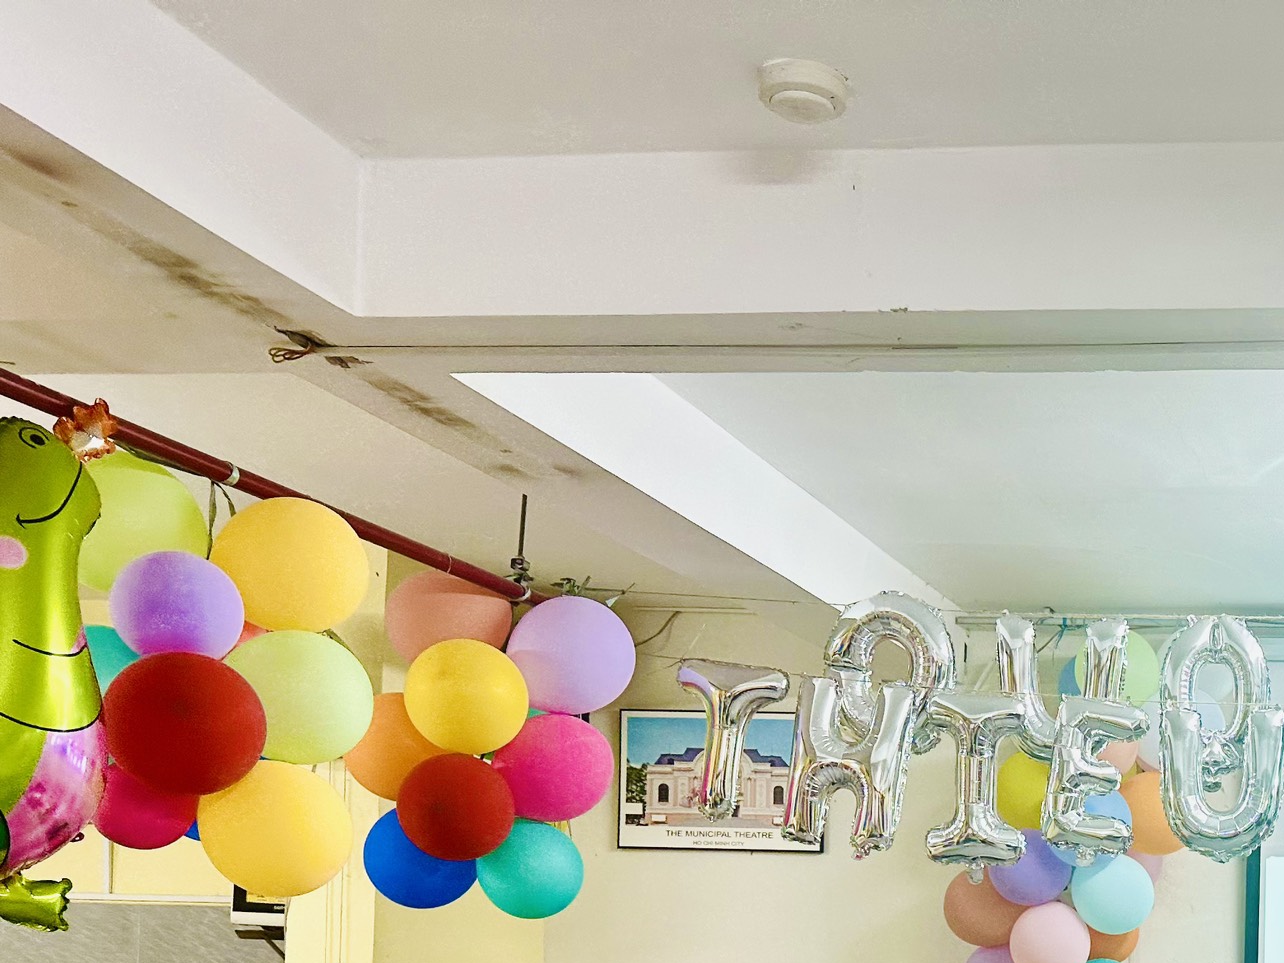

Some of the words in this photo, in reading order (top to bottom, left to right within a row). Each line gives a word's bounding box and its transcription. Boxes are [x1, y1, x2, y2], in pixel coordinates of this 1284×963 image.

[666, 829, 682, 837] THE
[685, 830, 731, 838] MUNICIPAL
[735, 831, 774, 839] THEATRE
